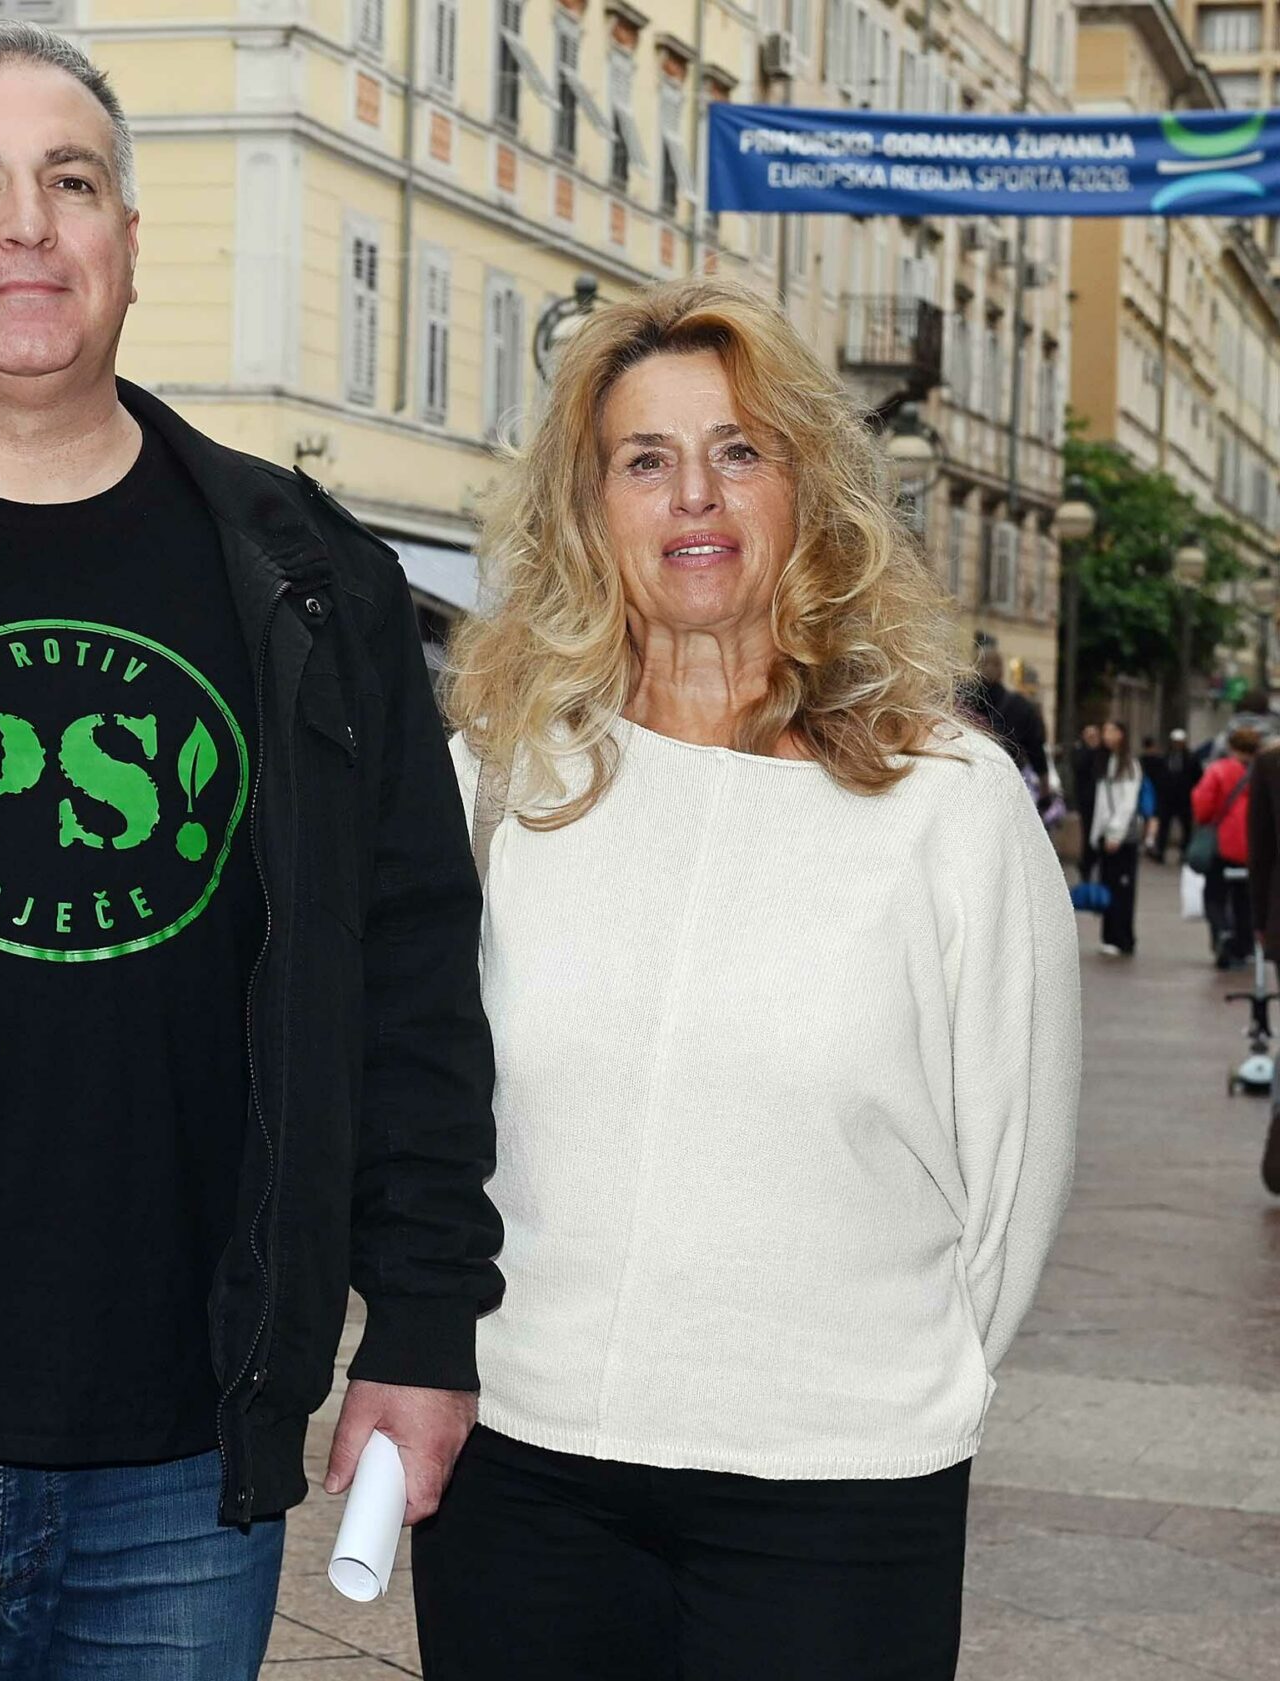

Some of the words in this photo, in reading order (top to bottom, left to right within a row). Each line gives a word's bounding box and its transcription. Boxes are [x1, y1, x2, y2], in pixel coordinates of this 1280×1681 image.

[1014, 128, 1135, 159] ŽUPANIJA
[768, 161, 887, 189] EUROPSKA
[890, 164, 973, 191] REGIJA
[976, 165, 1065, 192] SPORTA
